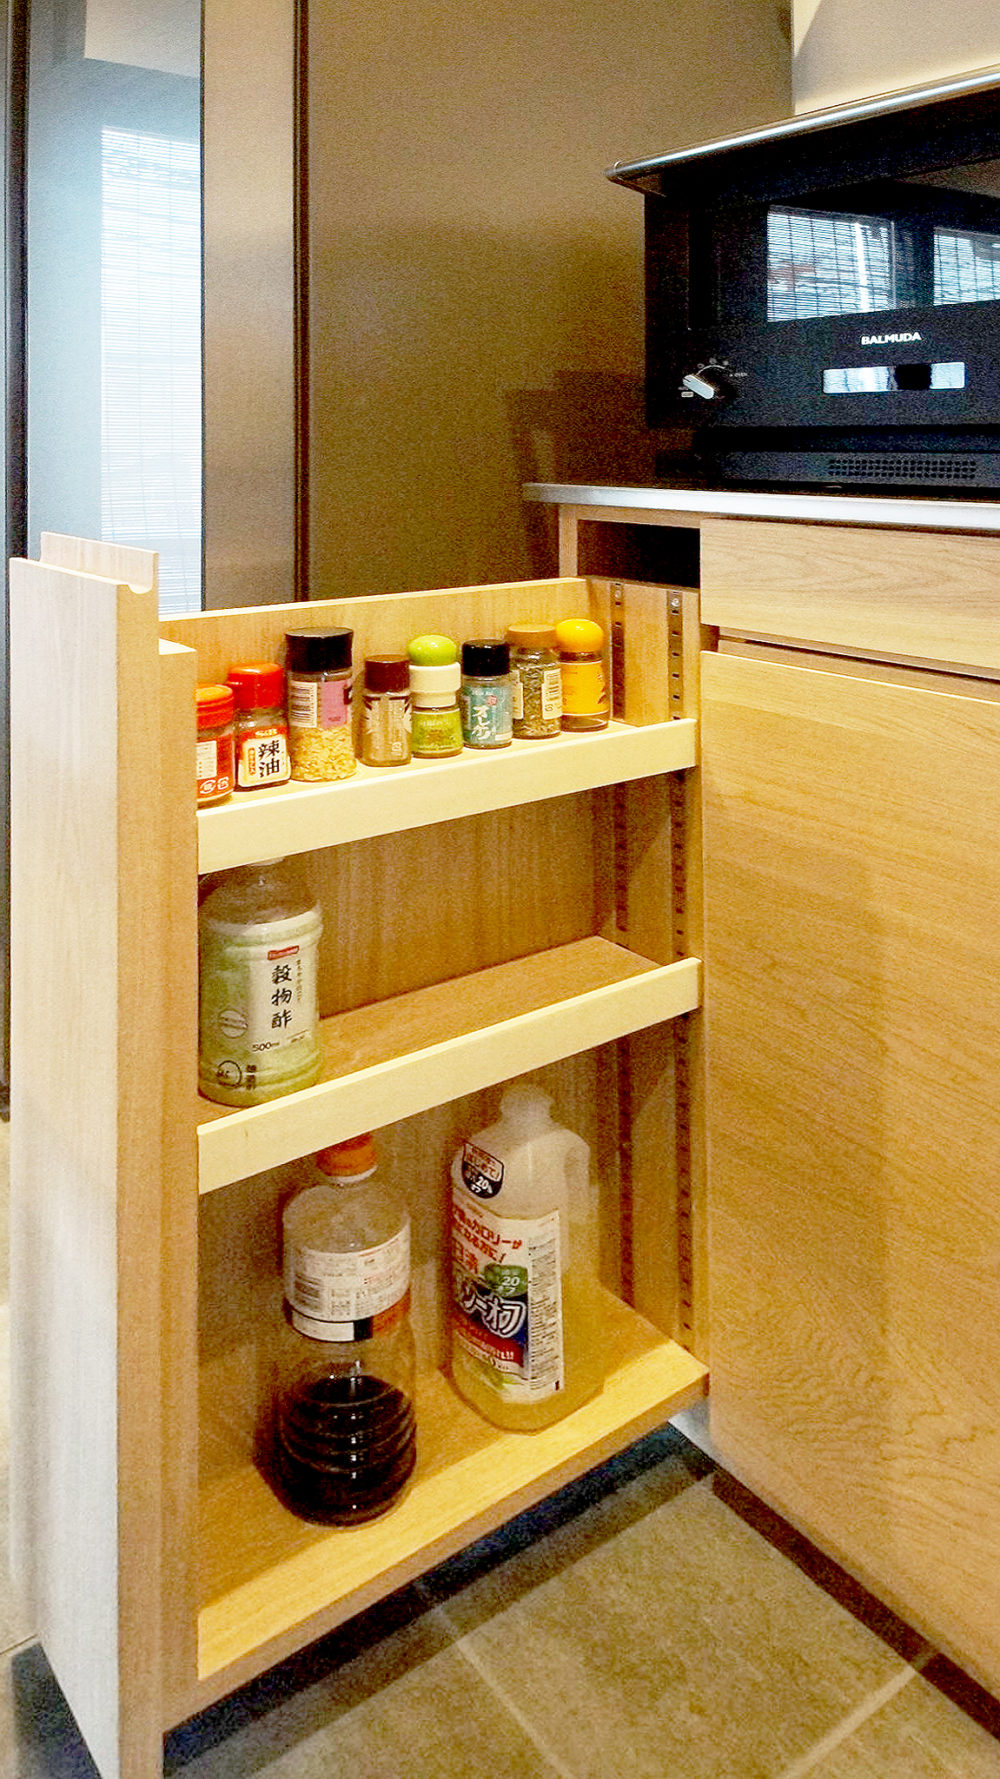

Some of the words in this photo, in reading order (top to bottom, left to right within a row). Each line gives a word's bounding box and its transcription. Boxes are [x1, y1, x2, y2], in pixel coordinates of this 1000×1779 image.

[861, 331, 922, 345] BALMUDA
[258, 740, 280, 778] 辣油
[271, 964, 293, 1029] 穀物酢
